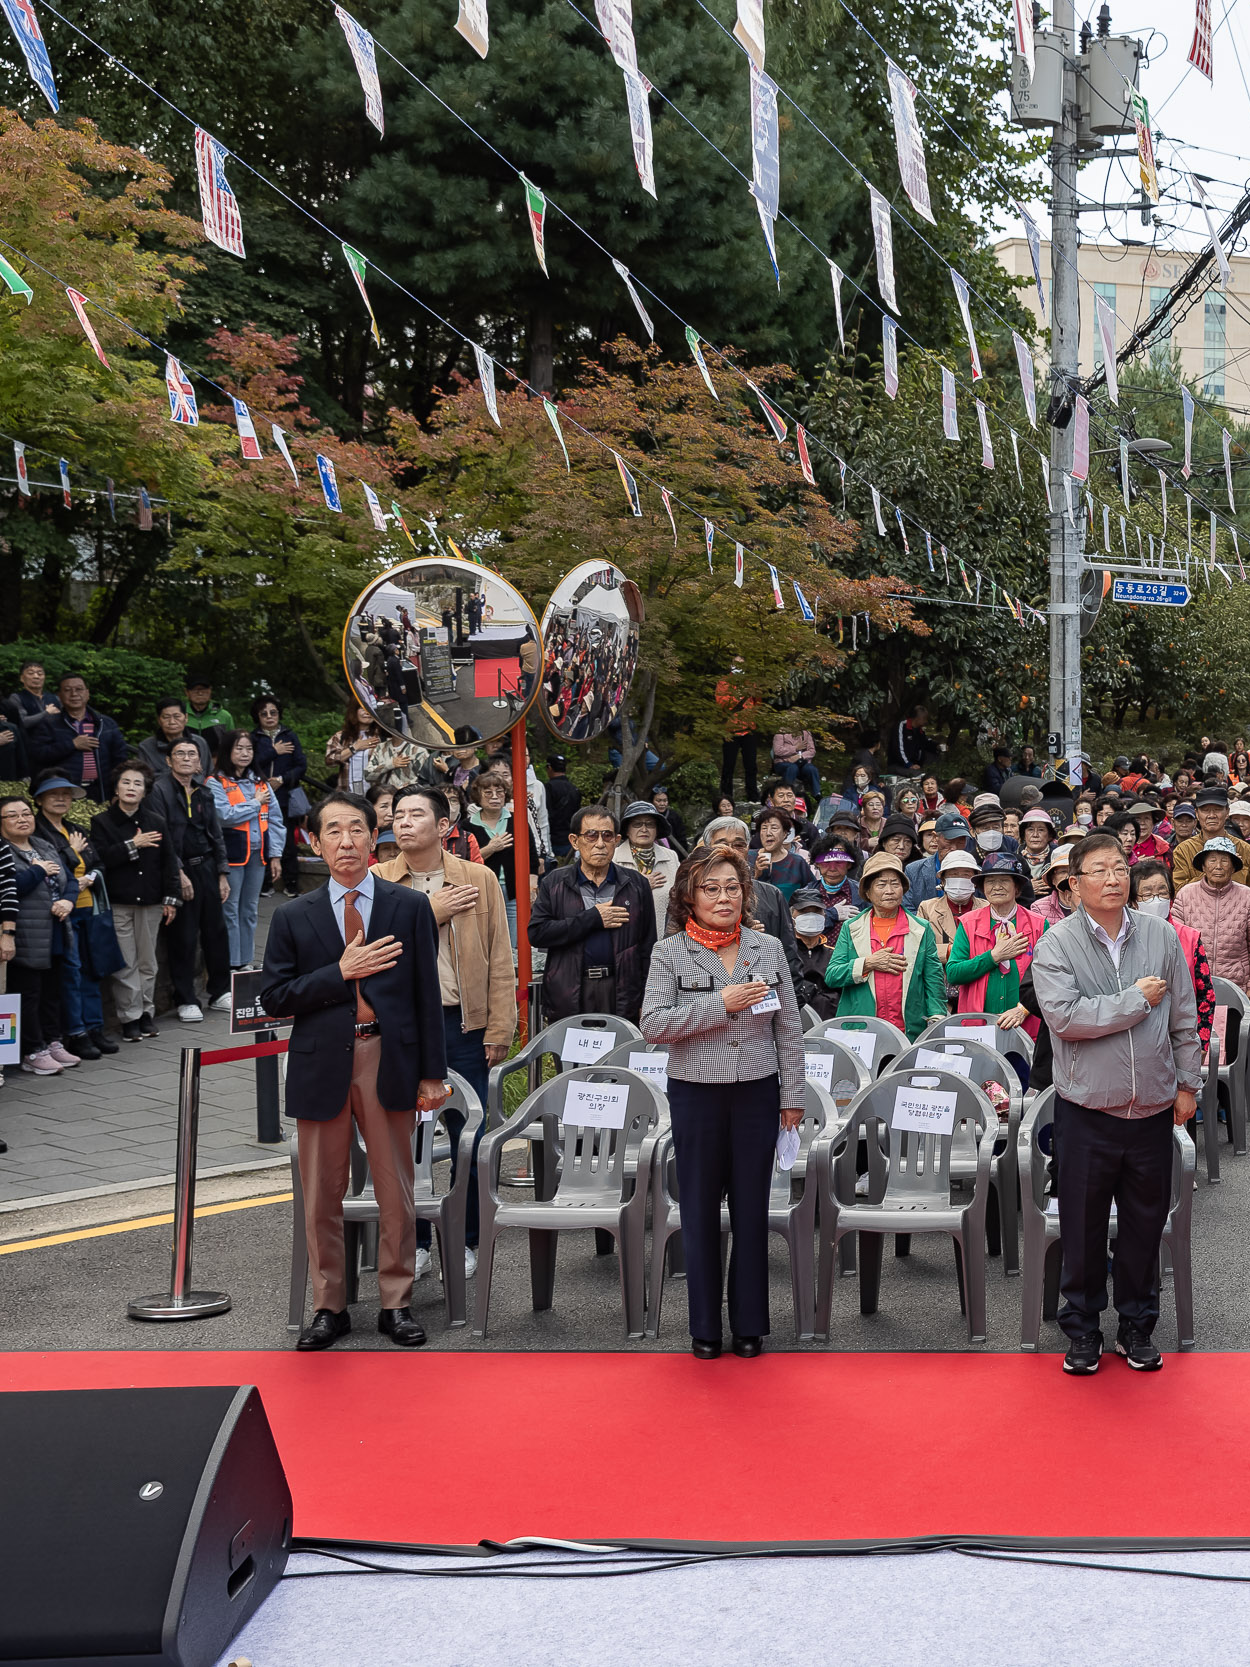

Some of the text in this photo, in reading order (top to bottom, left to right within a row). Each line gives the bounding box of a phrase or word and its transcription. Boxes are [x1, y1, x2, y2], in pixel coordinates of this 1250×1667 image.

[1116, 583, 1167, 597] 능동로26길
[1116, 592, 1172, 603] Neungdong-ro 26-gil
[235, 1007, 254, 1019] 진입
[578, 1039, 602, 1049] 내 빈
[805, 1062, 824, 1071] 을금고
[806, 1071, 830, 1079] 의회장
[577, 1092, 619, 1103] 광진구의회
[588, 1103, 606, 1111] 의장
[900, 1101, 951, 1113] 국민의힘 광진을
[907, 1109, 943, 1120] 당협위원장
